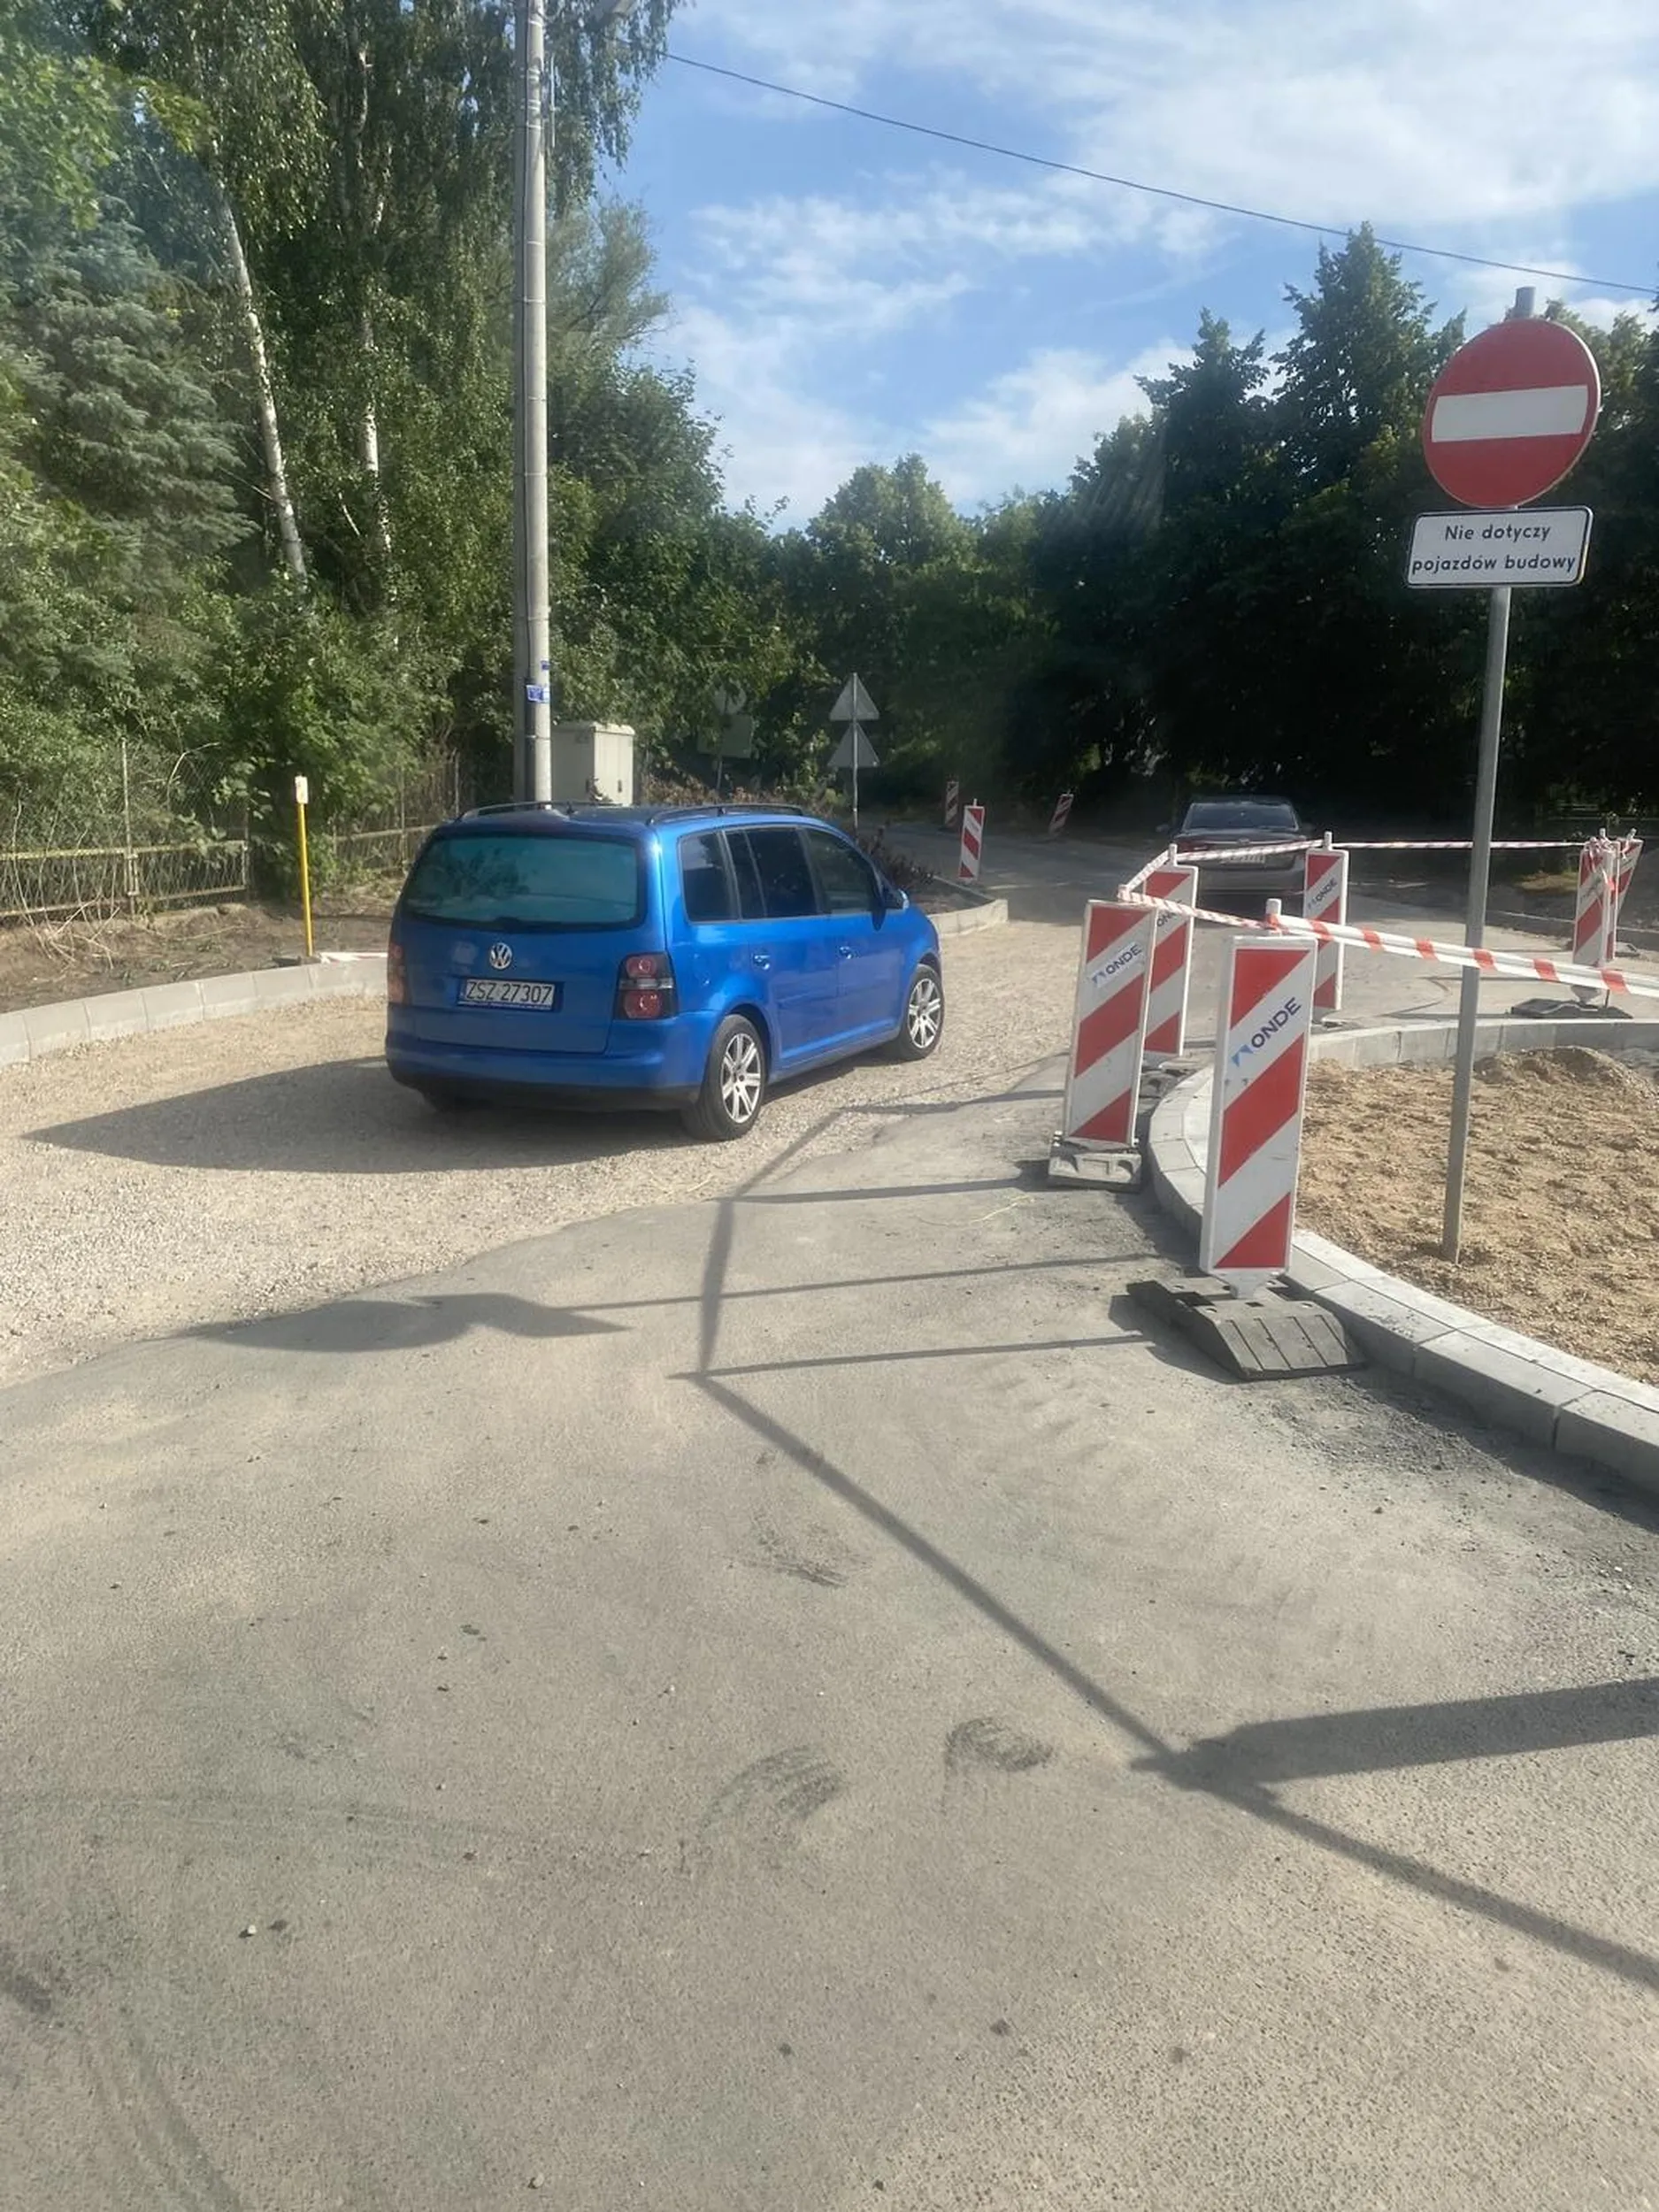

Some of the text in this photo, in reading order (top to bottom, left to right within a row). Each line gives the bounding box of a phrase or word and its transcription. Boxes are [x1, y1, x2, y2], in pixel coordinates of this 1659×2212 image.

[1445, 524, 1551, 542] Nie dotyczy
[1412, 554, 1576, 575] pojazdów budowy
[1106, 944, 1142, 974] ONDE
[466, 981, 552, 1003] ZSZ 27307
[1251, 996, 1302, 1048] ONDE
